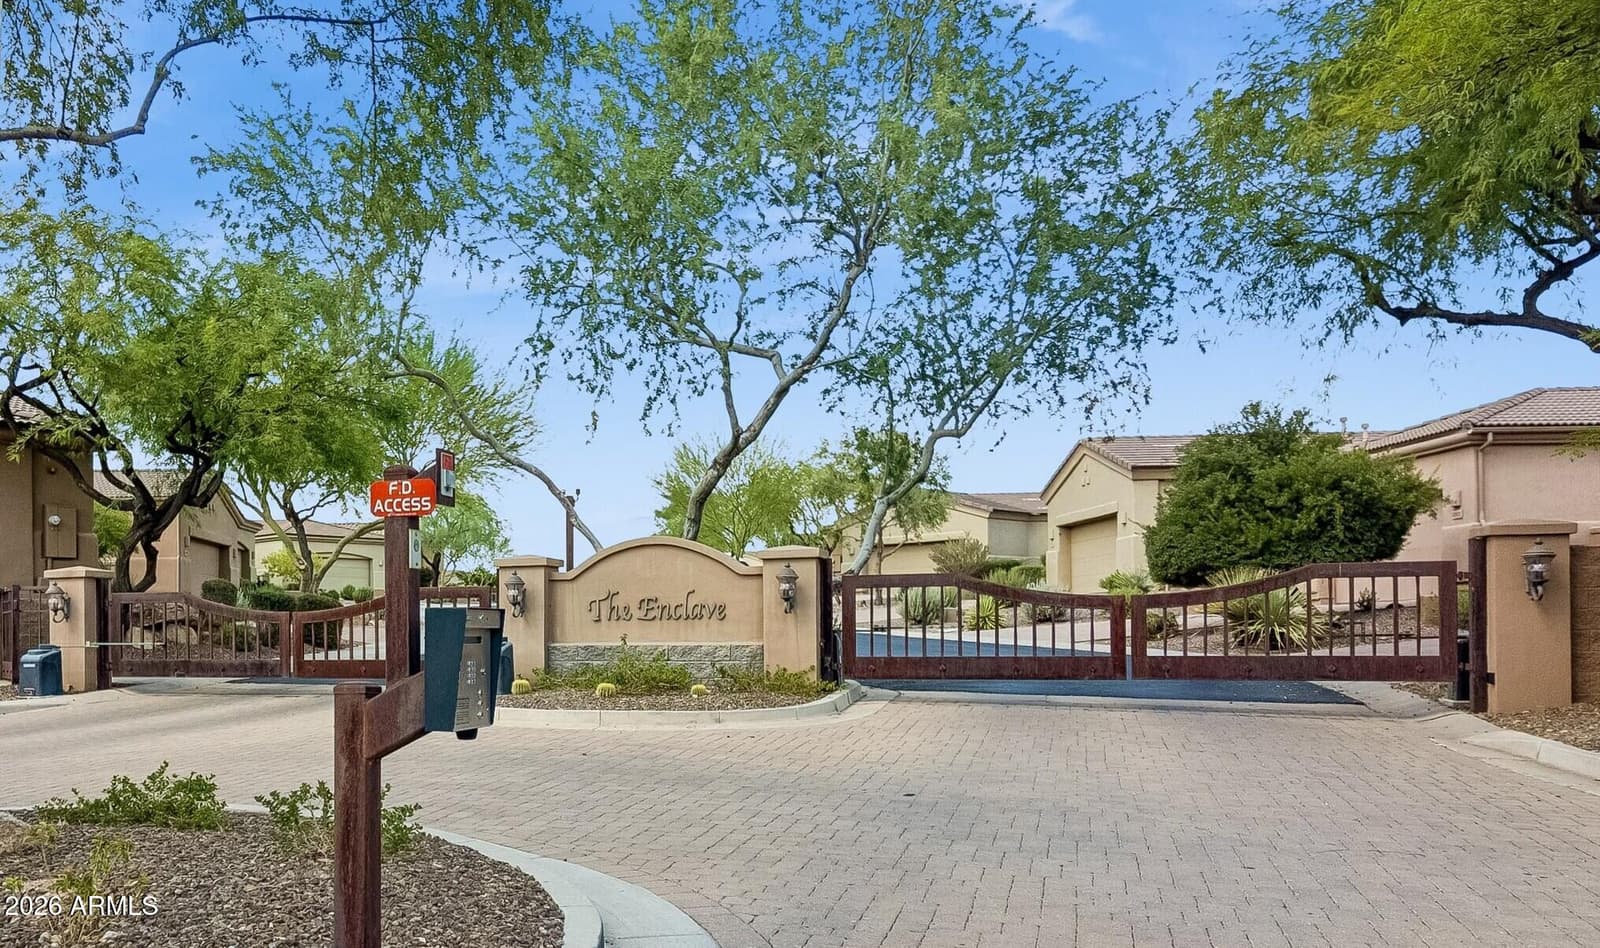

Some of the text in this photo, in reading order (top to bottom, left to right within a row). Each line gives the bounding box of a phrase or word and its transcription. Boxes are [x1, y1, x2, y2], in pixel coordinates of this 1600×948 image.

[388, 480, 416, 496] F.D.
[373, 496, 432, 513] ACCESS
[588, 589, 727, 622] The Enclave
